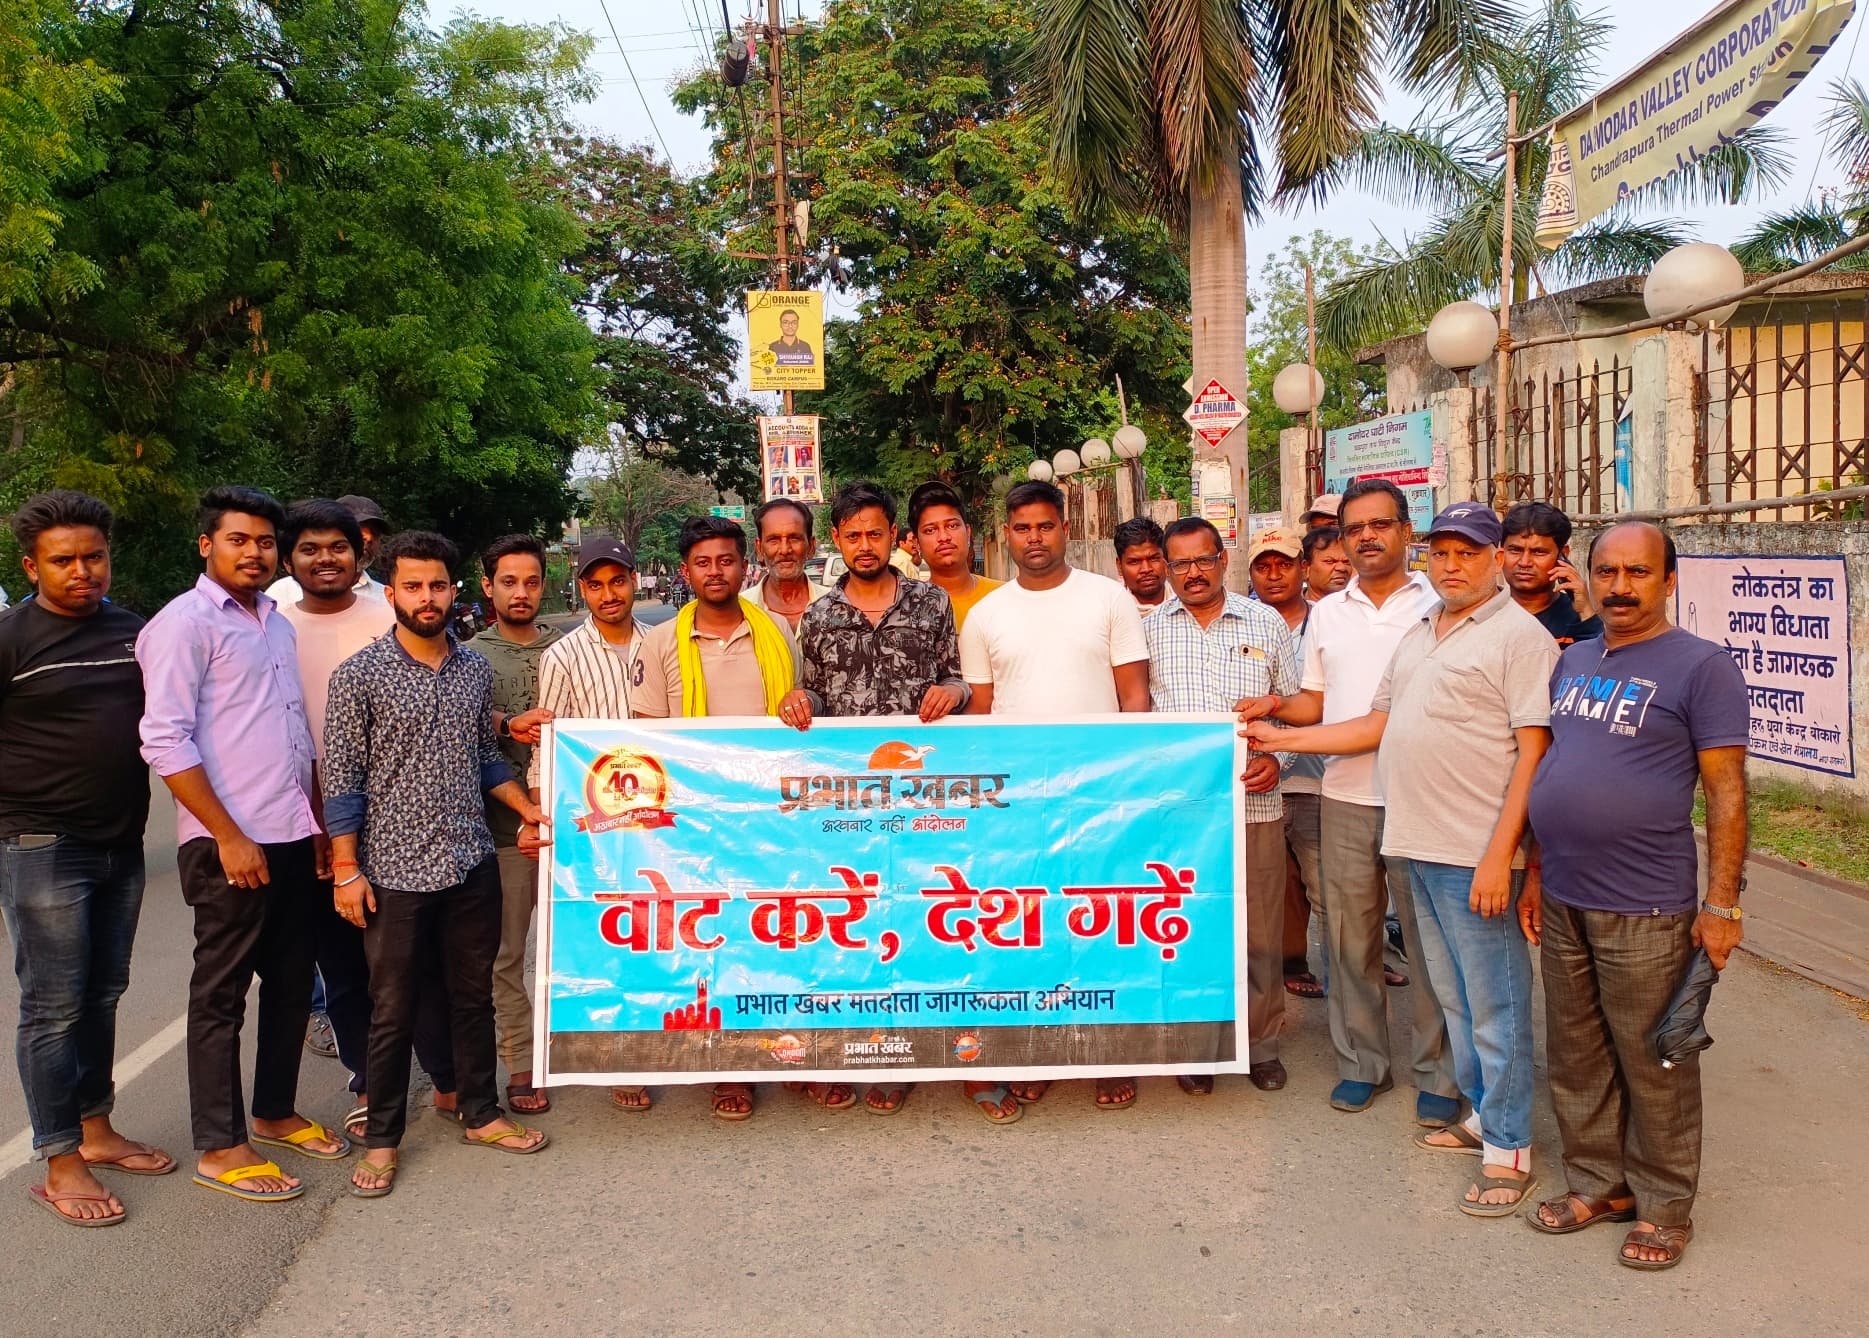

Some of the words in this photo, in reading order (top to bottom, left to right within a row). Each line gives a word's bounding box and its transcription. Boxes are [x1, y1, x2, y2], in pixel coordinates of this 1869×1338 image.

[1641, 61, 1694, 121] VALLEY
[1696, 0, 1806, 85] CORPORATON
[1590, 136, 1655, 183] Chandrapura
[1657, 106, 1702, 143] Thermal
[1707, 82, 1744, 114] Power
[772, 296, 810, 304] ORANGE
[1203, 402, 1236, 413] PHARMA
[1386, 421, 1408, 434] निगम
[1732, 566, 1802, 599] लोकतंत्र
[1808, 577, 1834, 600] का
[1728, 610, 1767, 634] भाग्य
[1771, 604, 1830, 640] विधाता
[634, 659, 644, 687] 3
[1752, 640, 1763, 674] है
[1767, 650, 1838, 678] जागरूक
[1767, 720, 1783, 738] युवा
[1786, 716, 1807, 741] केन्द्र
[1768, 739, 1779, 752] एवं
[603, 770, 639, 801] 40
[778, 775, 893, 813] प्रभात
[900, 774, 1011, 810] खबर
[822, 819, 872, 832] अखबार
[880, 815, 905, 833] नहीं
[912, 814, 967, 832] आंदोलन
[594, 869, 731, 951] वोट
[746, 866, 900, 962] करें,
[920, 866, 1048, 951] देश
[1061, 863, 1195, 959] गढ़ें
[736, 992, 788, 1016] प्रभात
[794, 993, 845, 1013] खबर
[848, 991, 920, 1014] मतदाता
[925, 990, 1029, 1012] जागरूकता
[1034, 984, 1115, 1011] अभियान
[843, 1056, 915, 1065] prabhatkhabar.com
[844, 1042, 879, 1054] प्रभात
[880, 1042, 913, 1053] खबर
